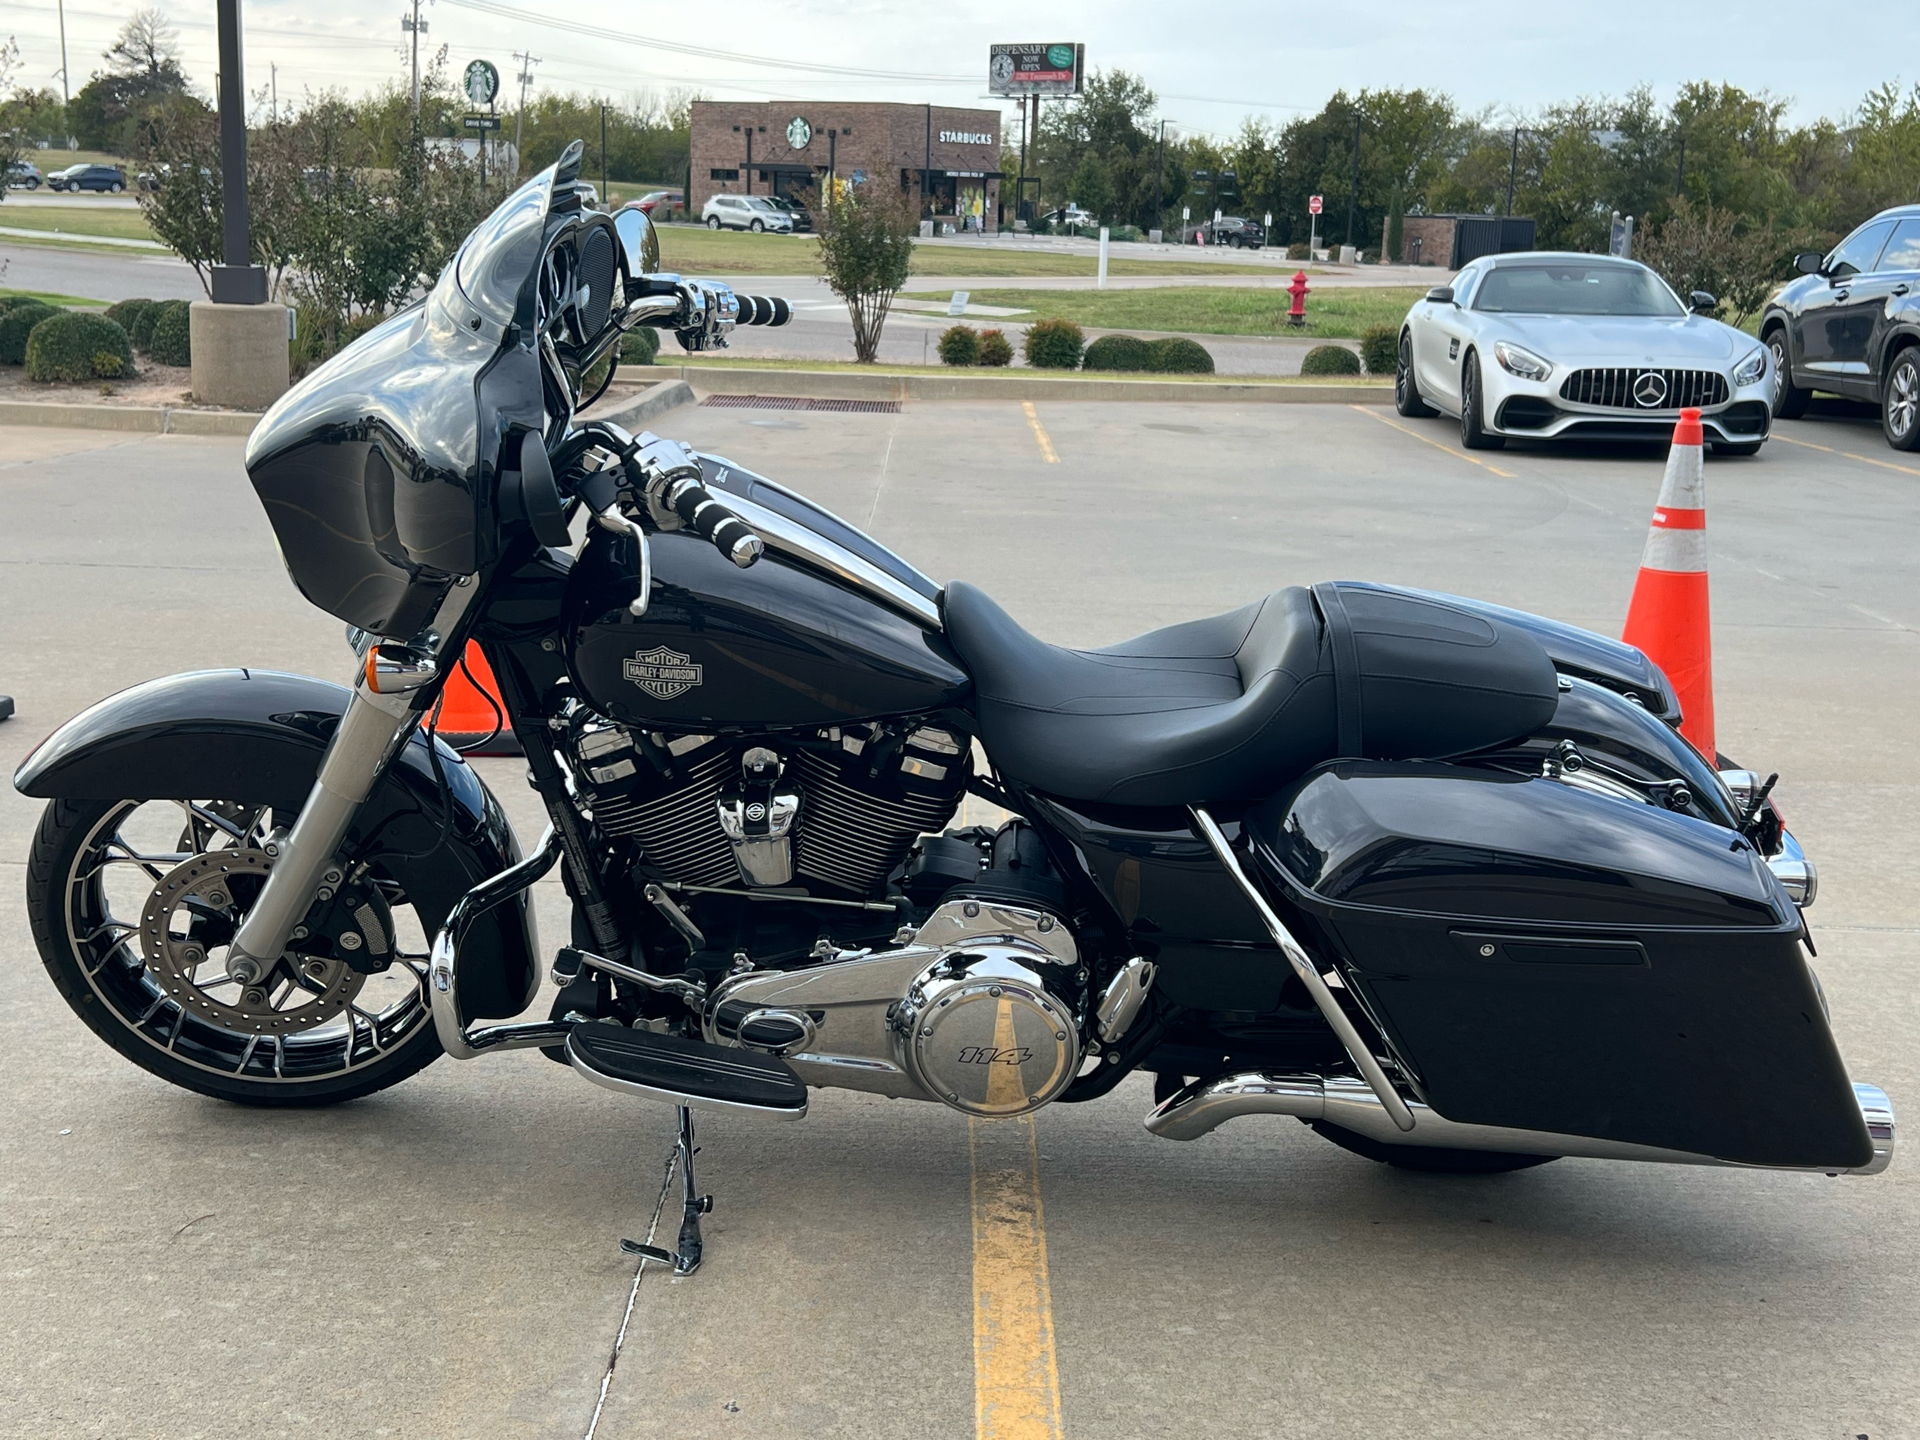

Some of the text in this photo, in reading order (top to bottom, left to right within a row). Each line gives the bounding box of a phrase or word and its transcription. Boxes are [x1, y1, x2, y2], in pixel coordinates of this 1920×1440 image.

[992, 45, 1047, 54] DISPENSARY
[1022, 55, 1040, 63] NOW
[1021, 63, 1040, 71] OPEN
[939, 130, 992, 145] STARBUCKS
[645, 652, 681, 666] MOTOR
[629, 664, 697, 681] HARLEY-DAVIDSON
[645, 680, 681, 695] CYCLES
[958, 1047, 1033, 1065] 114
